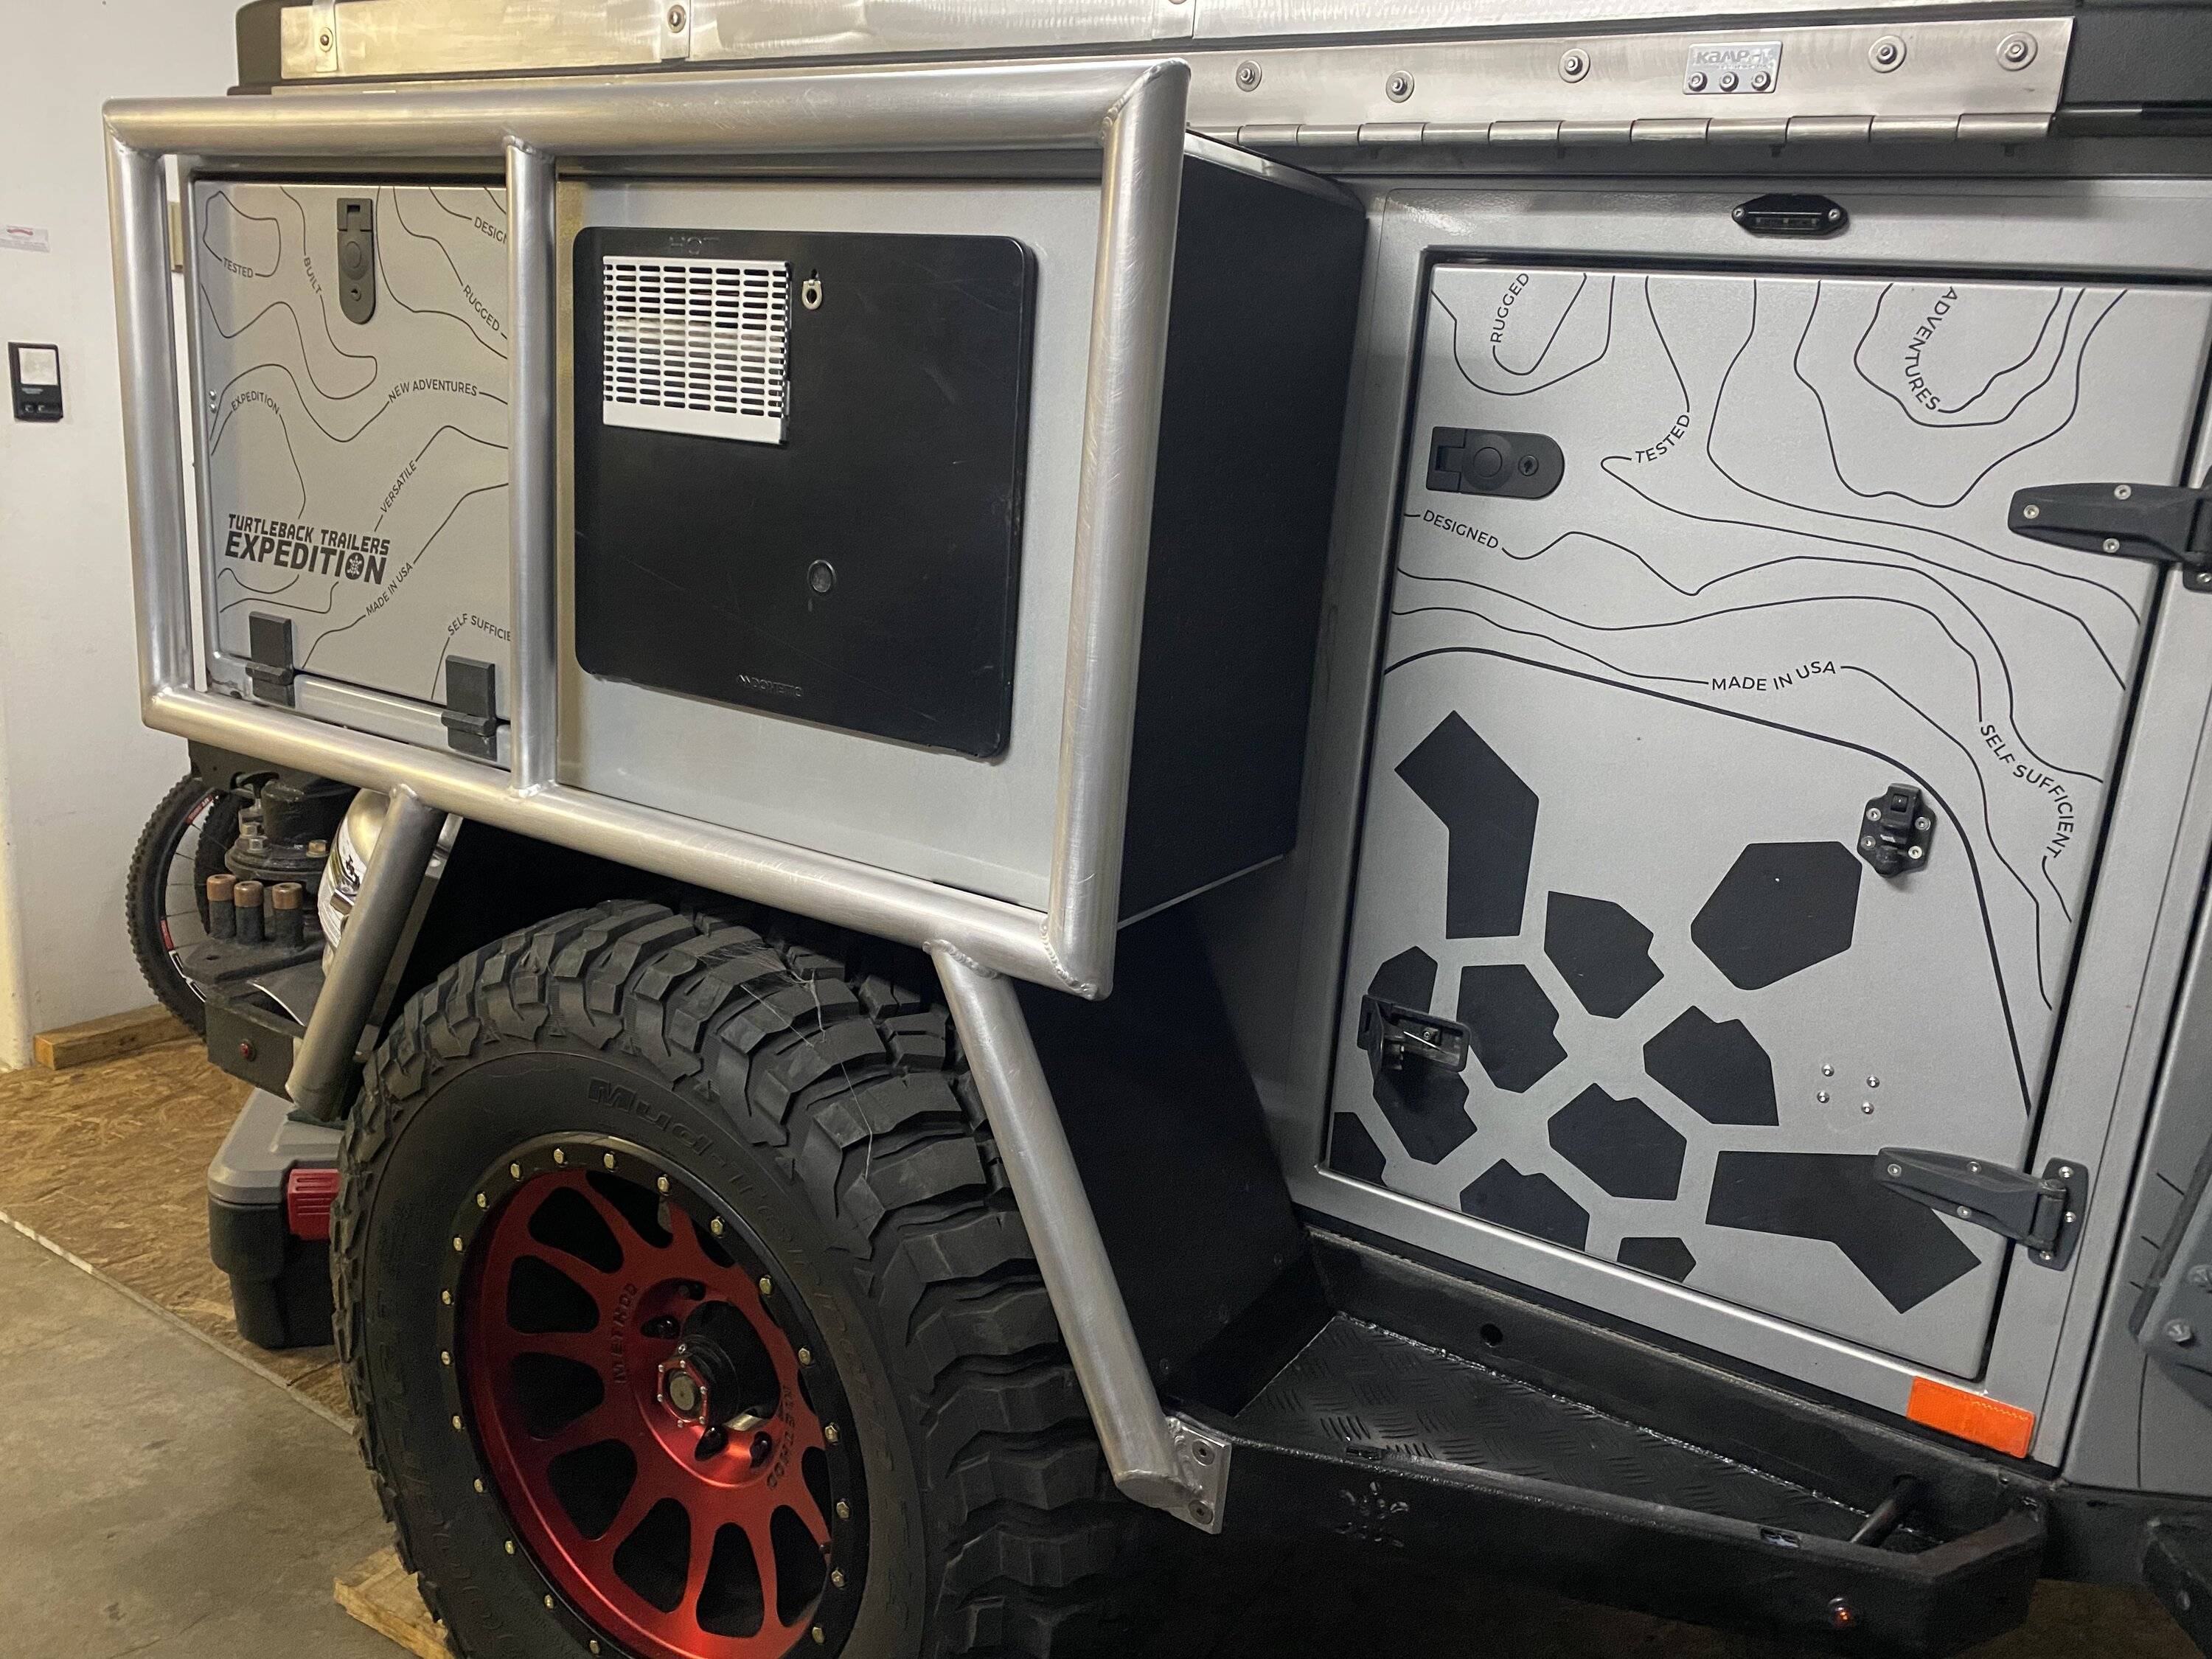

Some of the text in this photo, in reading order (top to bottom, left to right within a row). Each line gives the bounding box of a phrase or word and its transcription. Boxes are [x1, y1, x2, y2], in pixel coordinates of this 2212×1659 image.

[222, 258, 254, 279] TESTED
[303, 257, 322, 294] BUILT
[462, 285, 500, 332] RUGGED
[1490, 273, 1529, 343] RUGGED
[1905, 286, 1958, 411] ADVENTURES
[231, 391, 280, 415] EXPEDITION
[388, 380, 478, 403] NEW ADVENTURES
[1635, 414, 1690, 463] TESTED
[380, 460, 417, 514] VERSATILE
[228, 514, 391, 556] TURTLEBACK TRAILERS
[1423, 509, 1499, 549] DESIGNED
[224, 531, 387, 585] EXPEDITION
[366, 563, 414, 617] MADE IN USA
[448, 613, 467, 636] SELF
[1712, 661, 1836, 692] MADE IN USA
[1980, 723, 2074, 858] SELF SUFFICIENT
